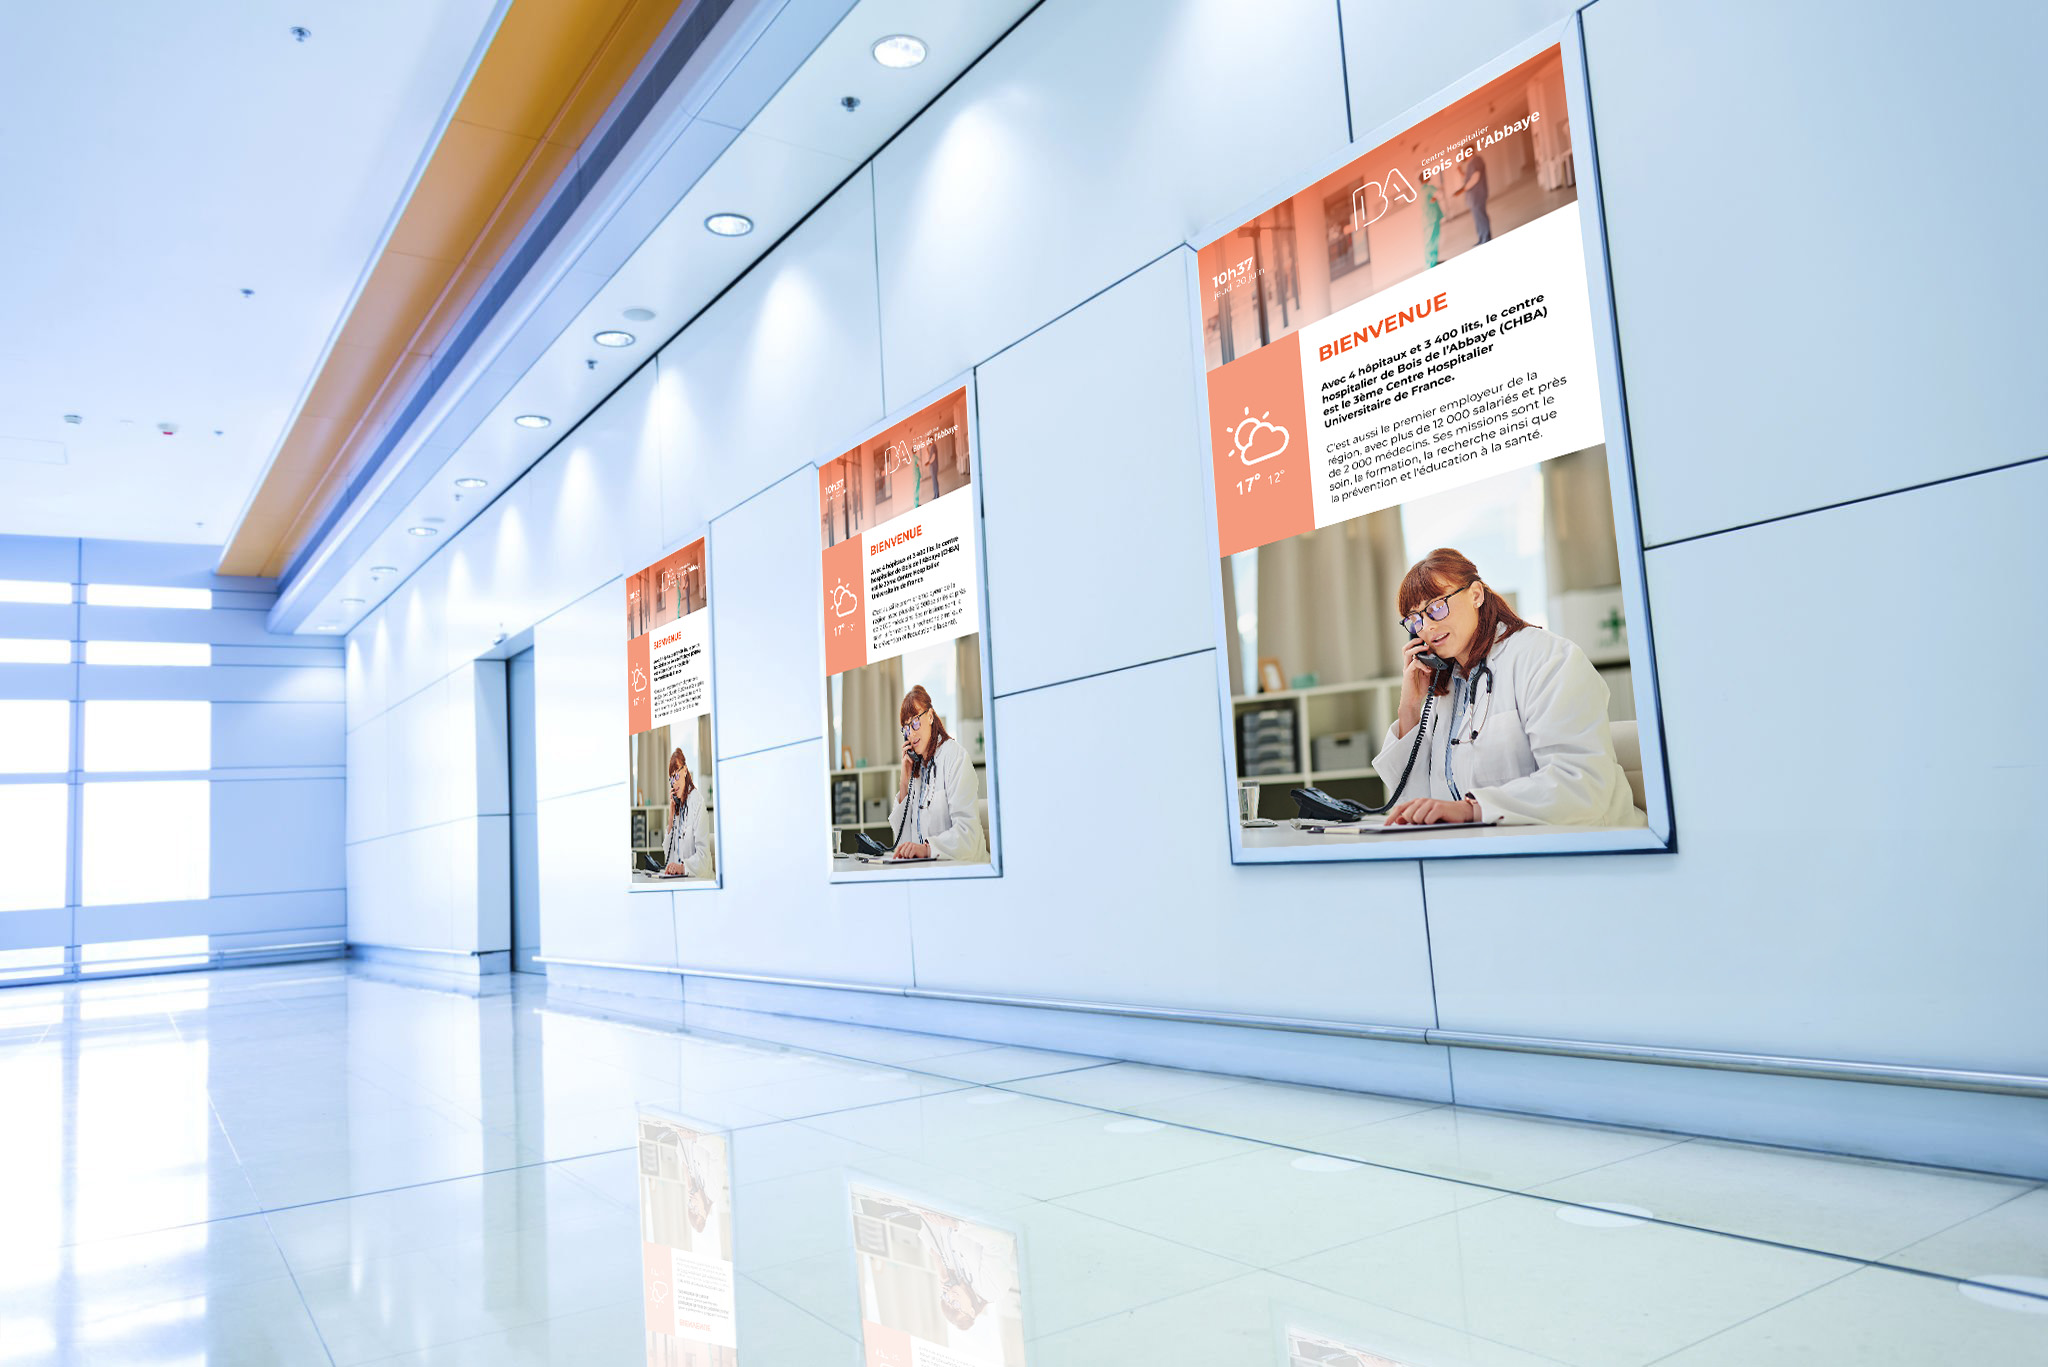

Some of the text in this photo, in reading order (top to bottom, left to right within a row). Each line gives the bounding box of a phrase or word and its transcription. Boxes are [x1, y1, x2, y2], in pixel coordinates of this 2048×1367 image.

[1421, 126, 1489, 167] Centre Hospitalier
[1422, 111, 1540, 180] Bois de l'Abbaye
[1212, 256, 1253, 288] 10h37
[1213, 283, 1234, 302] jeud
[1236, 276, 1247, 288] 20
[1319, 293, 1447, 361] BIENVENUE
[1321, 294, 1544, 391] Avec 4 hôpitaux et 3 400 lits, le centre
[1322, 306, 1547, 403] hospitalier de Bois de l'Abbaye (CHBA)
[1323, 344, 1493, 416] est le 3ème Centre Hospitalier
[1324, 375, 1454, 428] Universitaire de France.
[1326, 372, 1537, 453] C'est aussi le premier employeur de la
[1328, 376, 1567, 465] région, avec plus de 12 000 salariés et près
[1328, 396, 1554, 478] de 2 000 médecins. Ses missions sont le
[1329, 410, 1557, 491] soin, la formation, la recherche ainsi que
[1331, 430, 1542, 503] la prévention et l'éducation à la santé.
[870, 524, 923, 556] BIENVENUE
